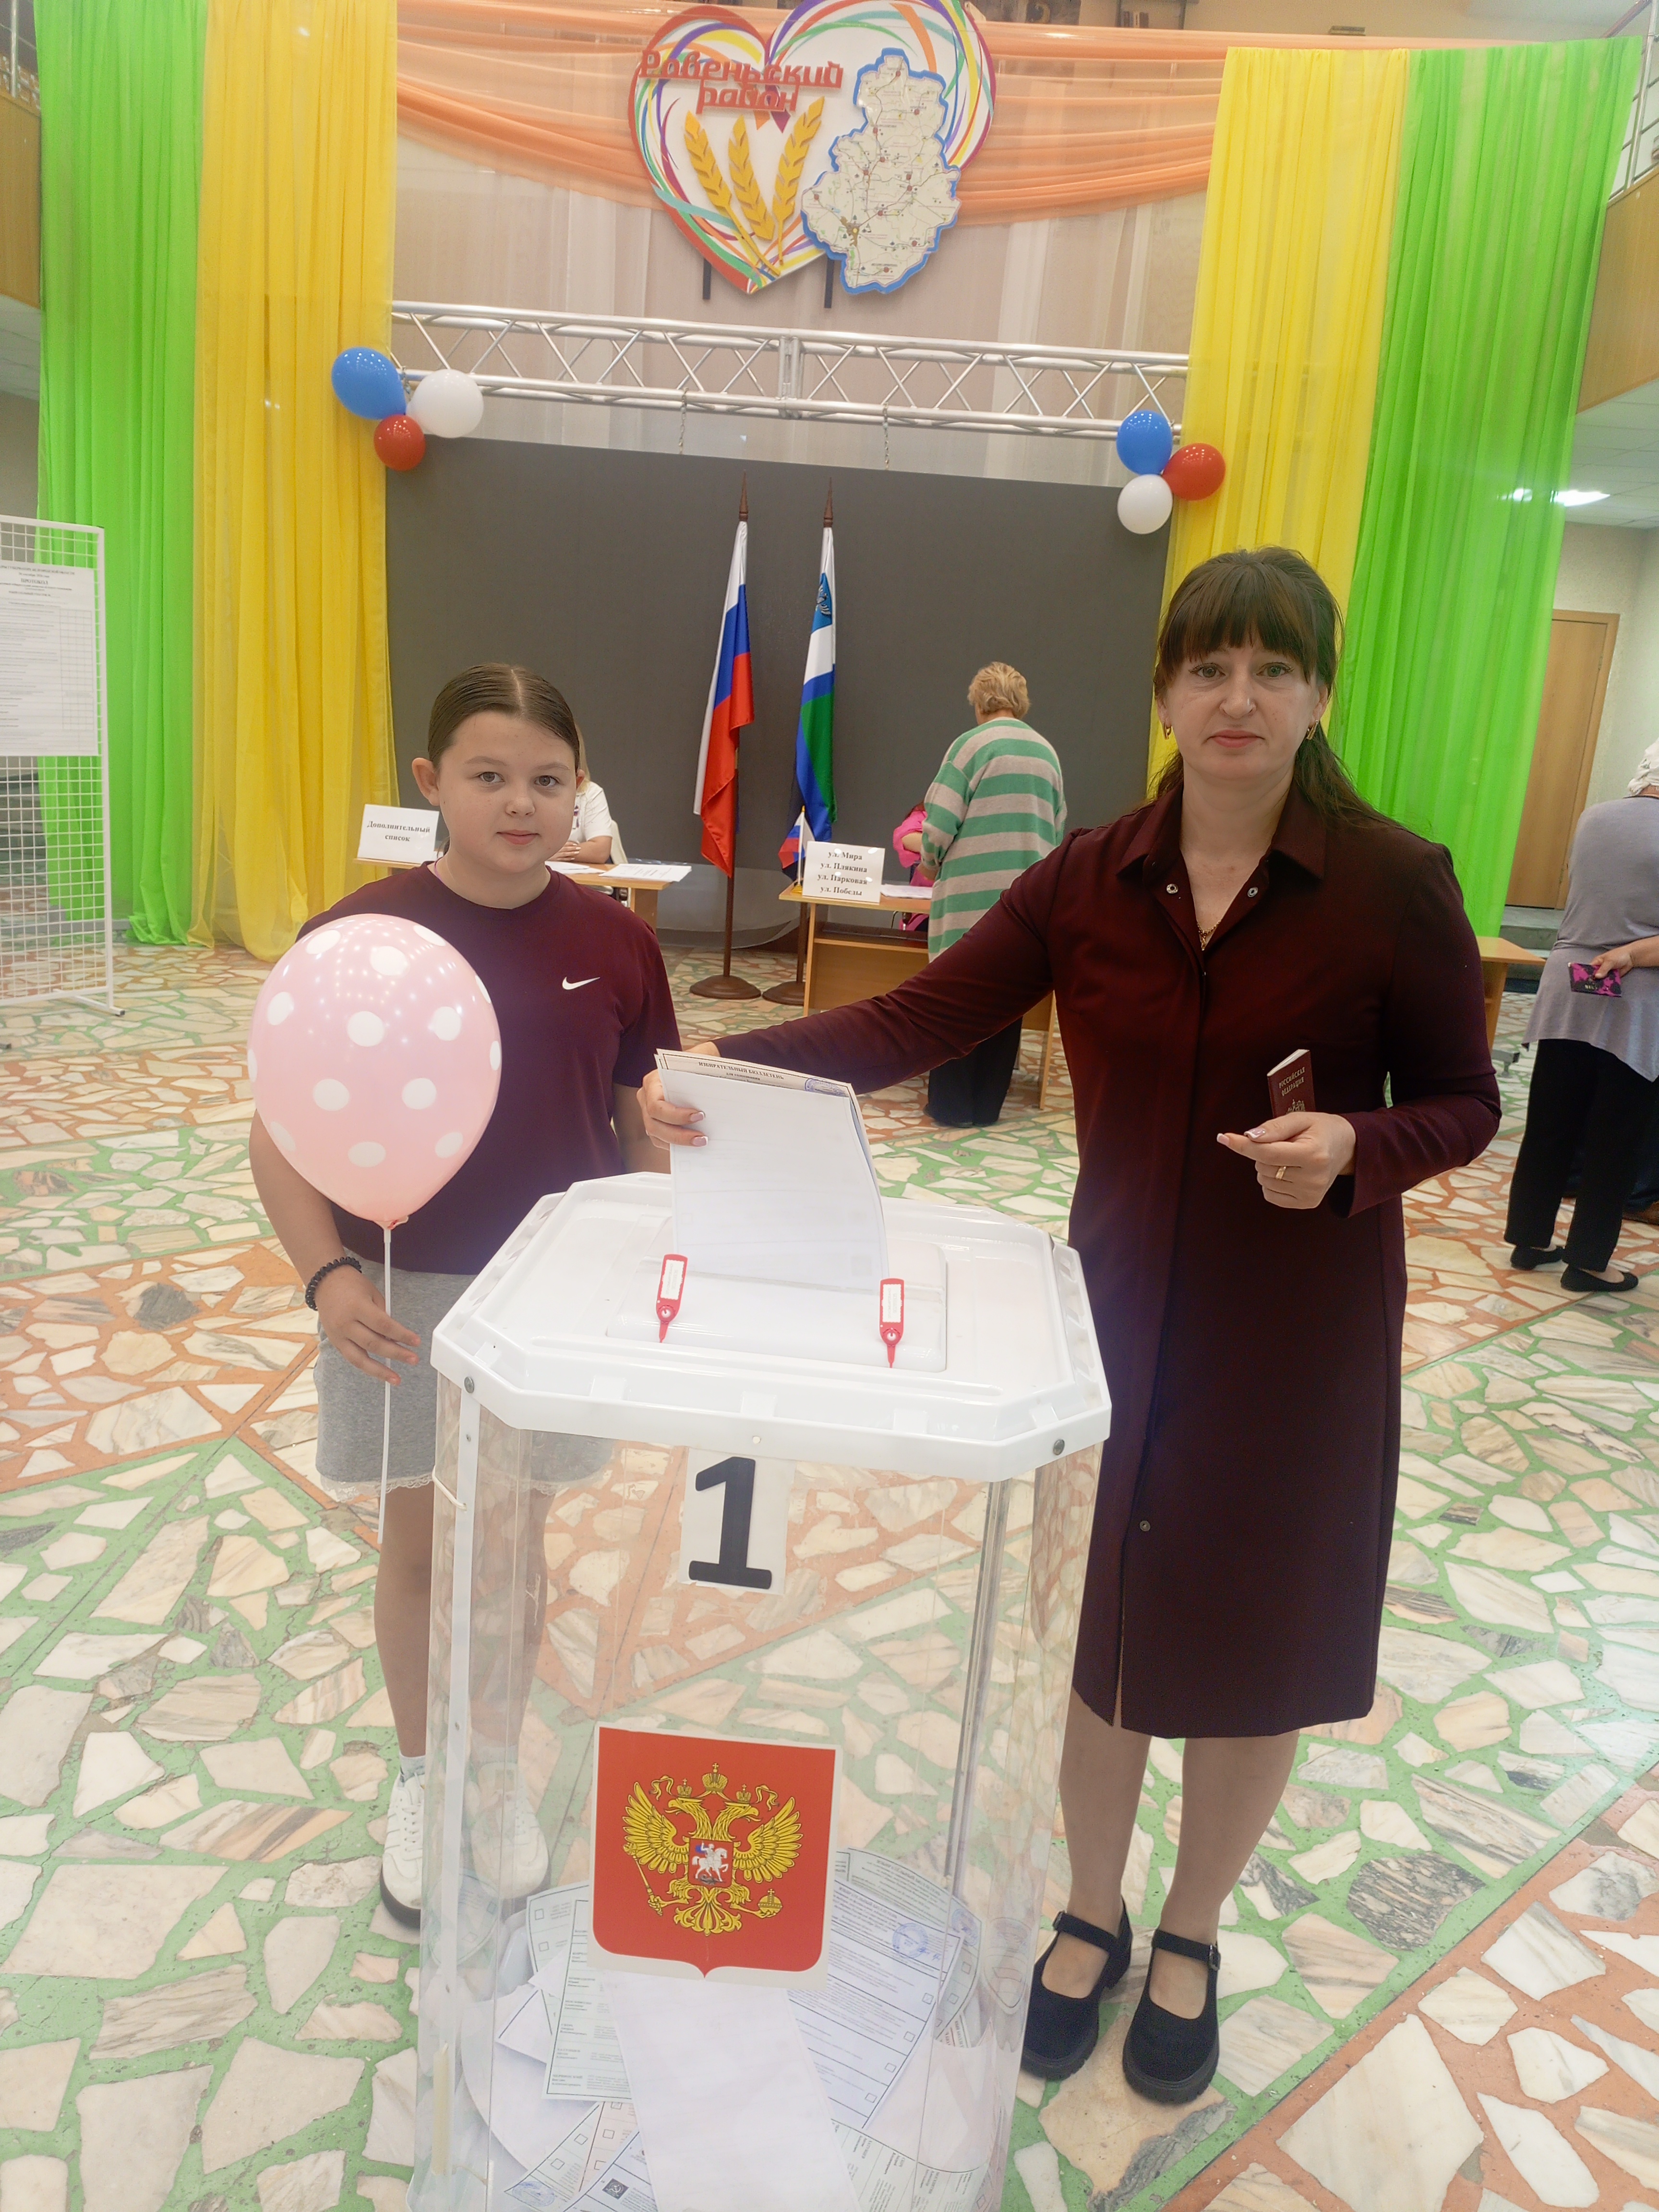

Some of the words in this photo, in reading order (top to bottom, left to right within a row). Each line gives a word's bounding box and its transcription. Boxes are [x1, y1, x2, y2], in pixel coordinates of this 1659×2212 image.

[639, 49, 844, 89] Ровеньский
[696, 80, 800, 114] район
[367, 820, 431, 833] Дополнительный
[385, 834, 410, 842] список
[842, 852, 863, 861] Мира
[834, 863, 867, 873] Плякина
[830, 874, 867, 885] Парковая
[833, 886, 863, 896] Победы
[698, 1061, 748, 1073] ИЗБИРАТЕЛЬНЫЙ
[748, 1069, 784, 1080] БЮЛЛЕТЕНЬ
[1279, 1067, 1305, 1088] РОССИЙСКАЯ
[1281, 1077, 1304, 1096] ФЕДЕРАЦИЯ
[688, 1456, 772, 1590] 1
